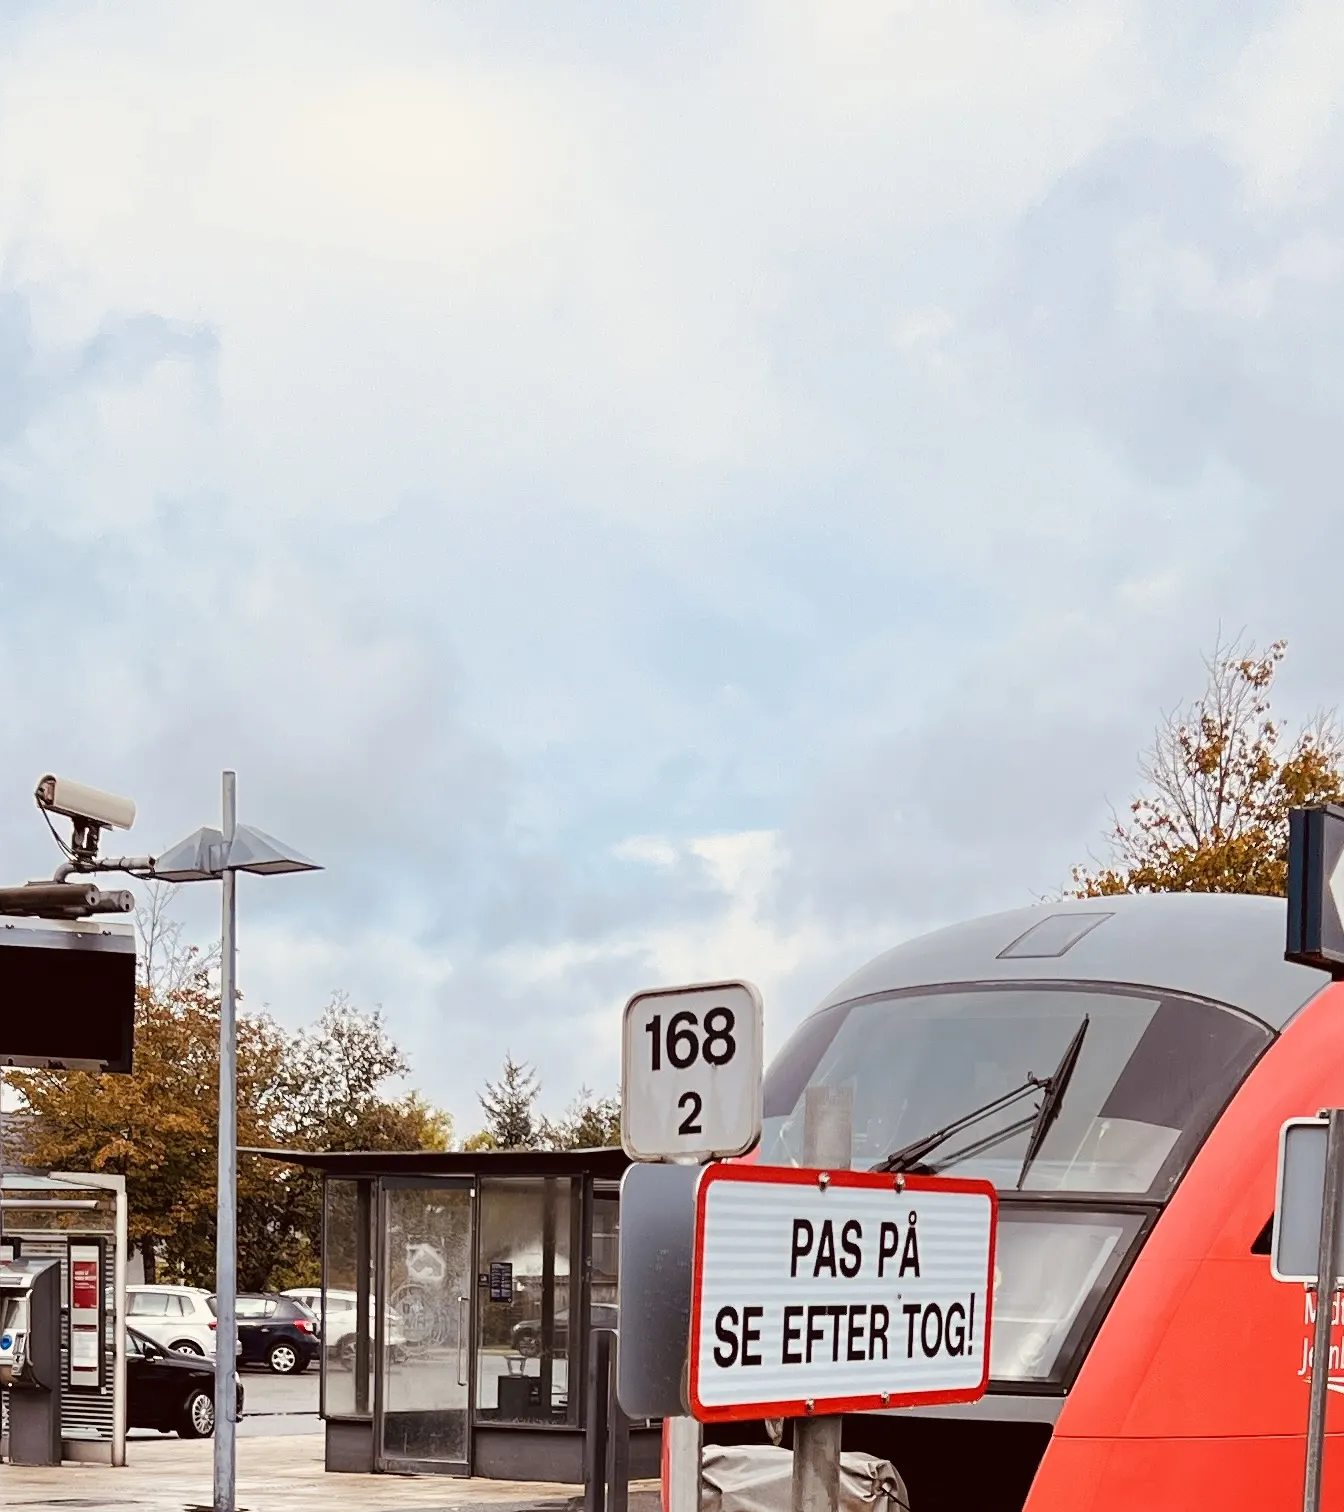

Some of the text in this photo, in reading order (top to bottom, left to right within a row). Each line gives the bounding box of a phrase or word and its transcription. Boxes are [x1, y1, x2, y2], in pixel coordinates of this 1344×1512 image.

[644, 1007, 737, 1071] 168
[677, 1091, 703, 1136] 2
[790, 1210, 921, 1278] PAS PÅ
[713, 1292, 976, 1369] SE EFTER TOG!
